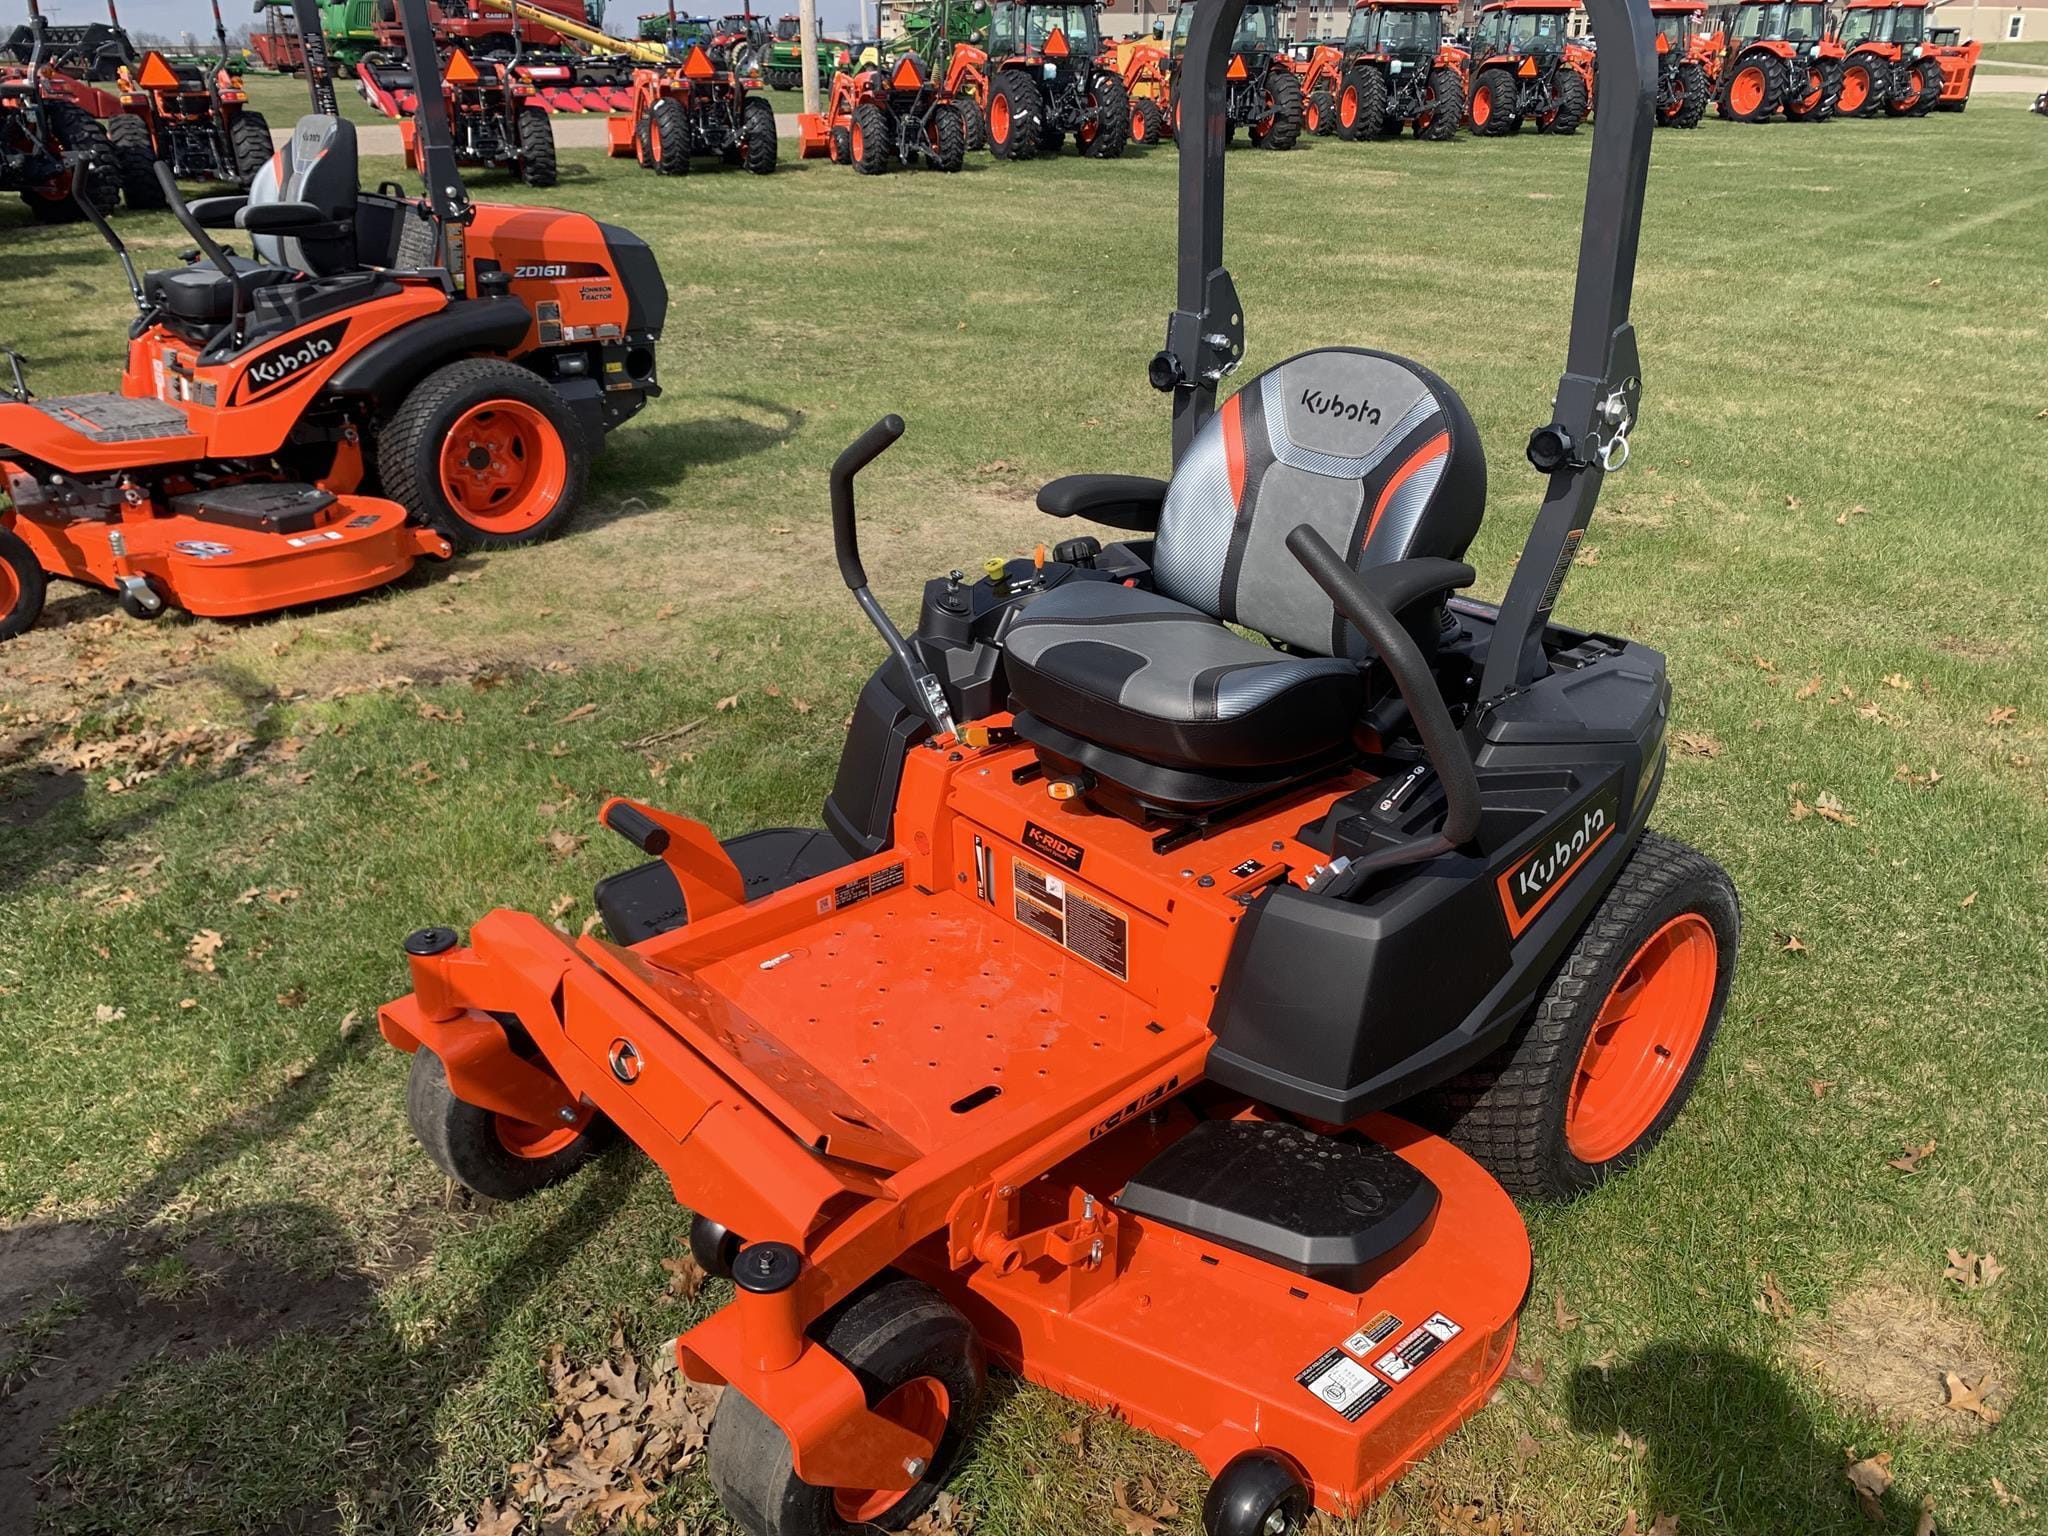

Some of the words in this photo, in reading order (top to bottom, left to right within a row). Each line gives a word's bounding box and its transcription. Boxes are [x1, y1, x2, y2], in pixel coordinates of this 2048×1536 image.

[514, 265, 567, 278] ZD1611
[250, 339, 333, 382] Kubota
[1301, 389, 1381, 426] Kubota
[1029, 828, 1079, 860] K-RIDE
[1519, 808, 1605, 895] Kubota
